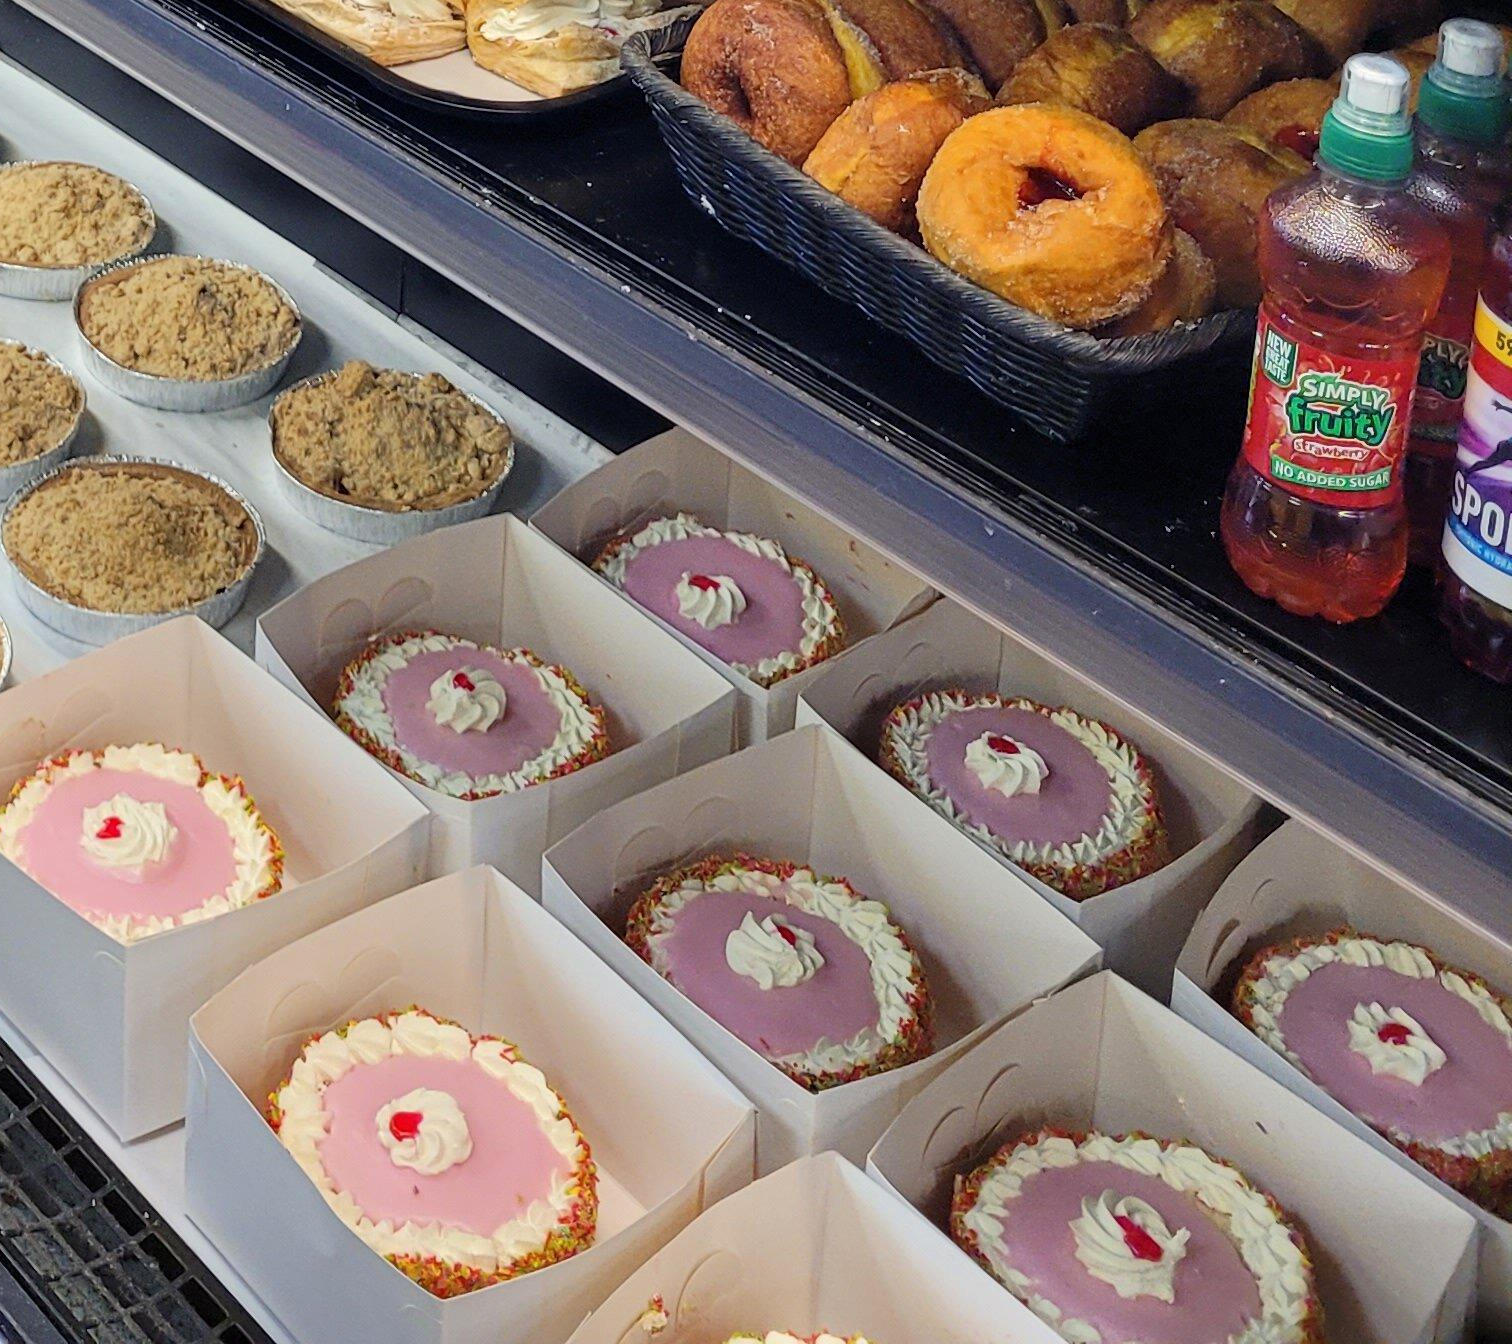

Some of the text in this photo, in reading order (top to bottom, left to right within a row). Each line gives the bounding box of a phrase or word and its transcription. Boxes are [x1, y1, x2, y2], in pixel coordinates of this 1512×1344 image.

[1268, 330, 1292, 357] NEW
[1264, 359, 1287, 383] TASTE
[1303, 379, 1385, 410] SIMPLY
[1288, 397, 1394, 445] fruity
[1295, 440, 1368, 460] strawberry
[1275, 461, 1390, 488] NO ADDED SUGAR
[1452, 470, 1512, 554] SPO
